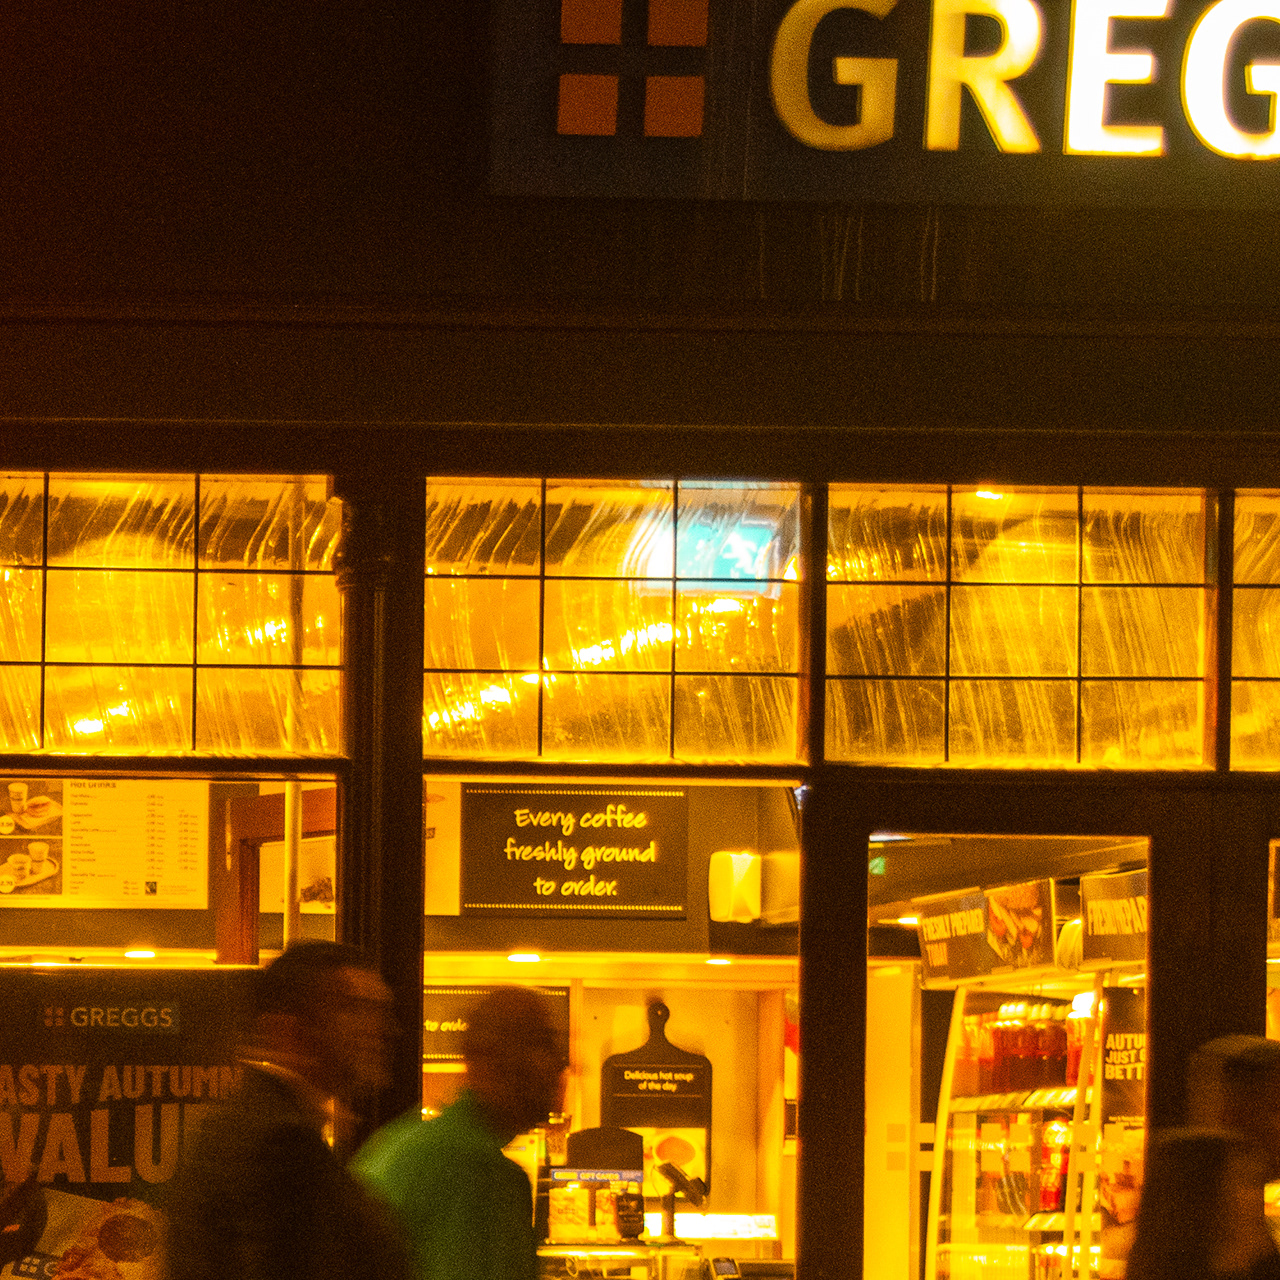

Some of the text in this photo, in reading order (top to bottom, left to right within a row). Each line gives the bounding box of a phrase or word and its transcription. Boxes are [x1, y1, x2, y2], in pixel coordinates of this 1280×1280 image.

[514, 804, 647, 836] Every coffee
[504, 837, 656, 870] freshly ground
[533, 874, 617, 896] to order.
[70, 1007, 173, 1027] GREGGS
[1106, 1049, 1137, 1064] JUST
[98, 1064, 245, 1101] AUTUMN
